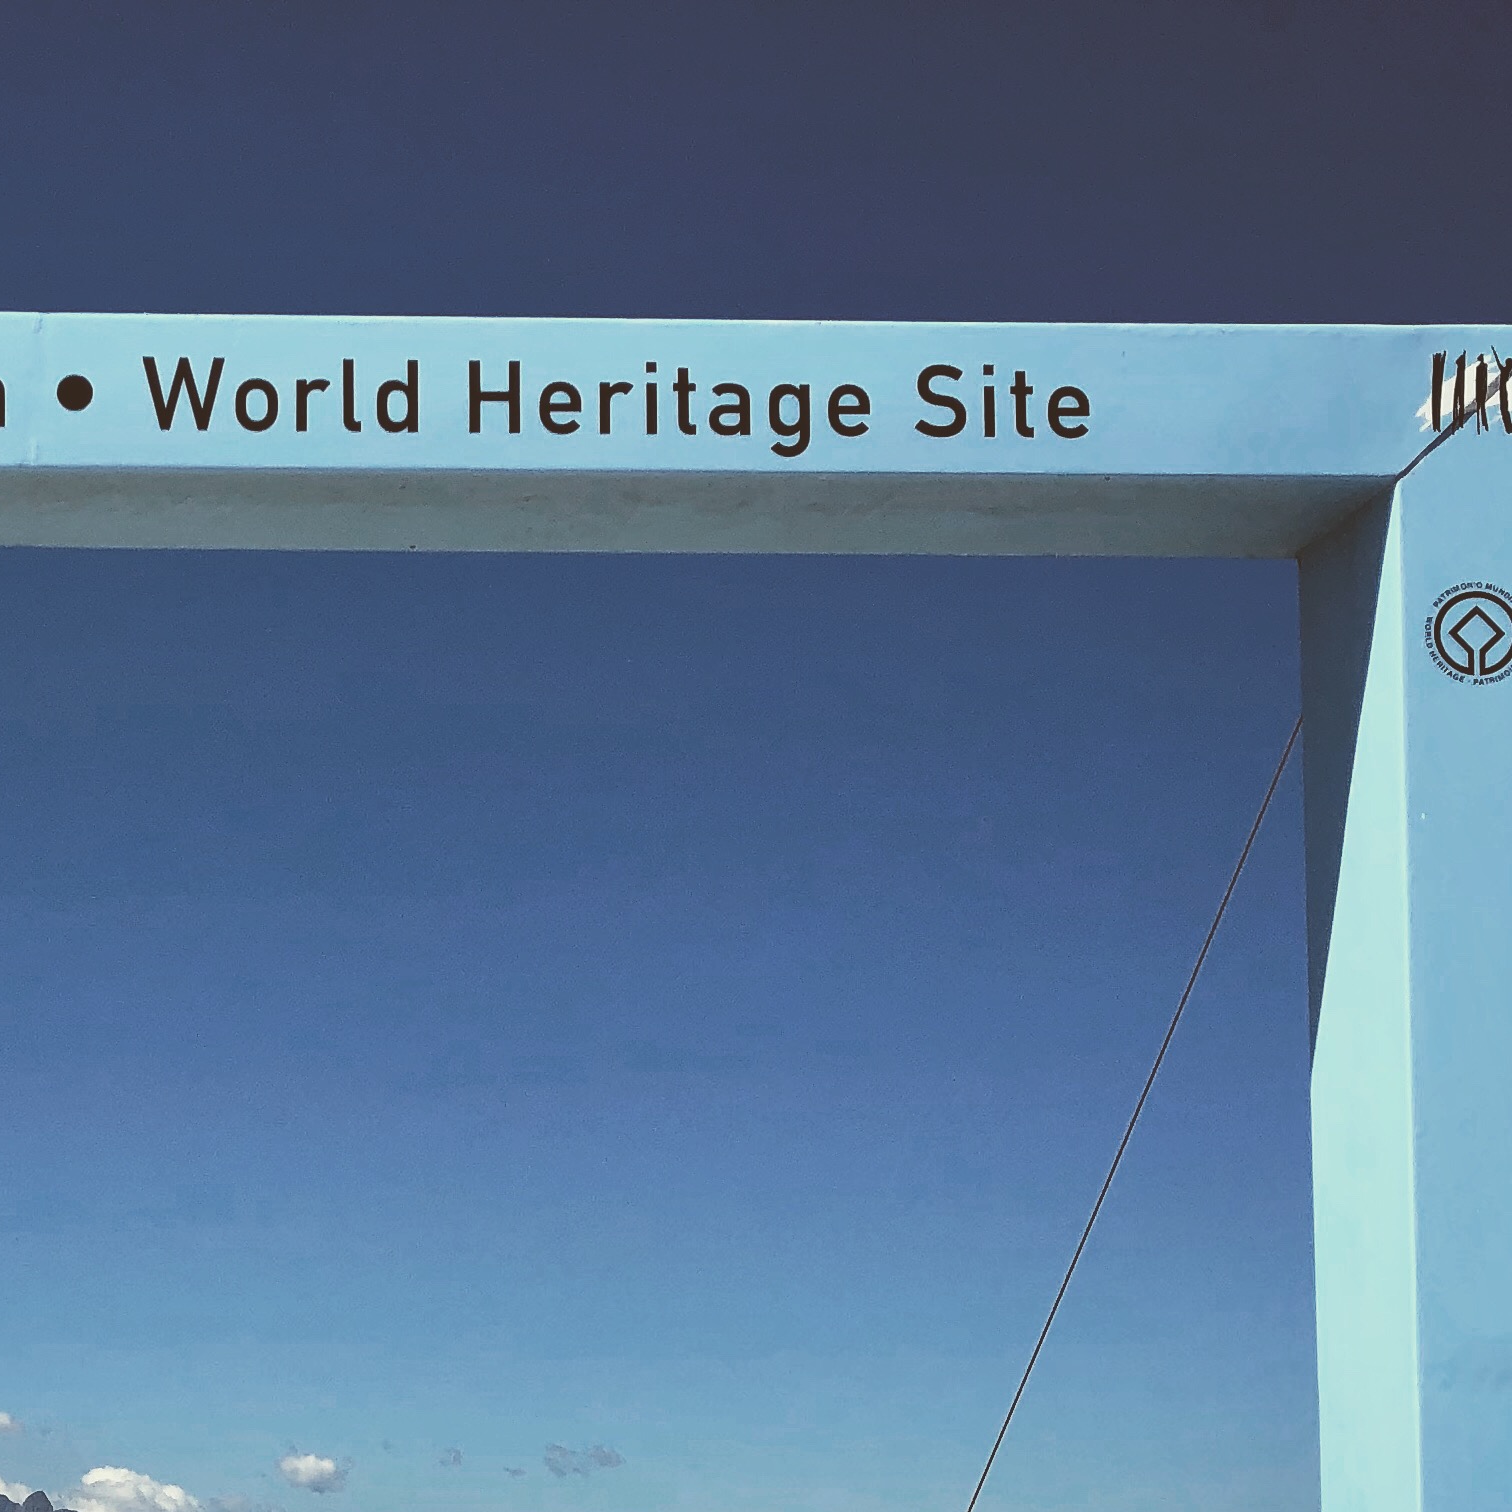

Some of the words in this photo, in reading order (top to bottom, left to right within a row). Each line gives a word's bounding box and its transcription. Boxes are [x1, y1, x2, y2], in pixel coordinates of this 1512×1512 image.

[143, 356, 419, 433] World
[468, 360, 871, 458] Heritage
[914, 363, 1091, 439] Site
